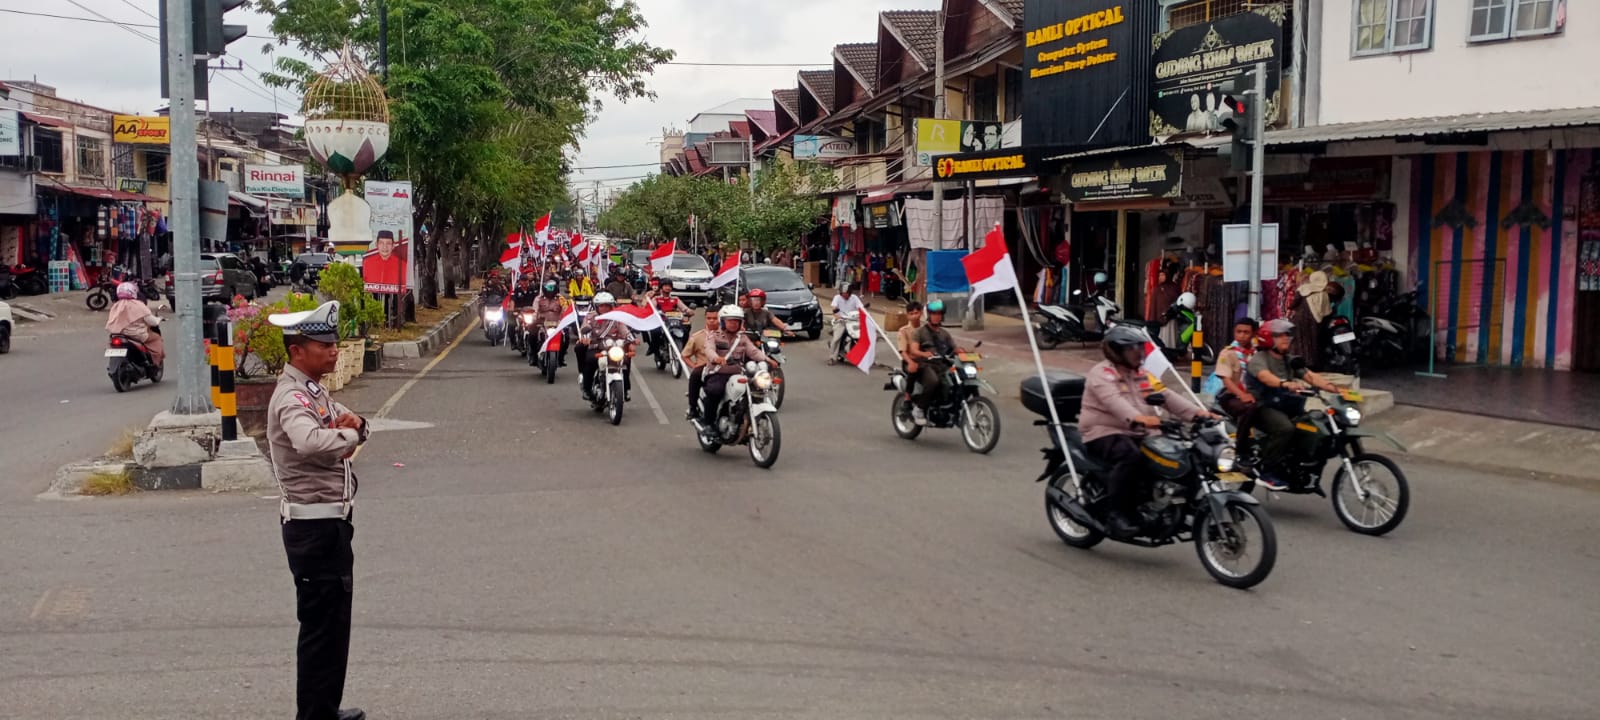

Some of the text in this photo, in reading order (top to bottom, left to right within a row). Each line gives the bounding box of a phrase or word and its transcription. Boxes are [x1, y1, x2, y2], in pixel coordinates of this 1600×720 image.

[1065, 6, 1124, 36] OPTICAL
[1038, 38, 1108, 62] Computer System
[1156, 54, 1202, 79] GUDANG
[115, 124, 167, 137] AA SPORT
[983, 154, 1026, 171] OPTICAL
[250, 169, 295, 181] Rinnai
